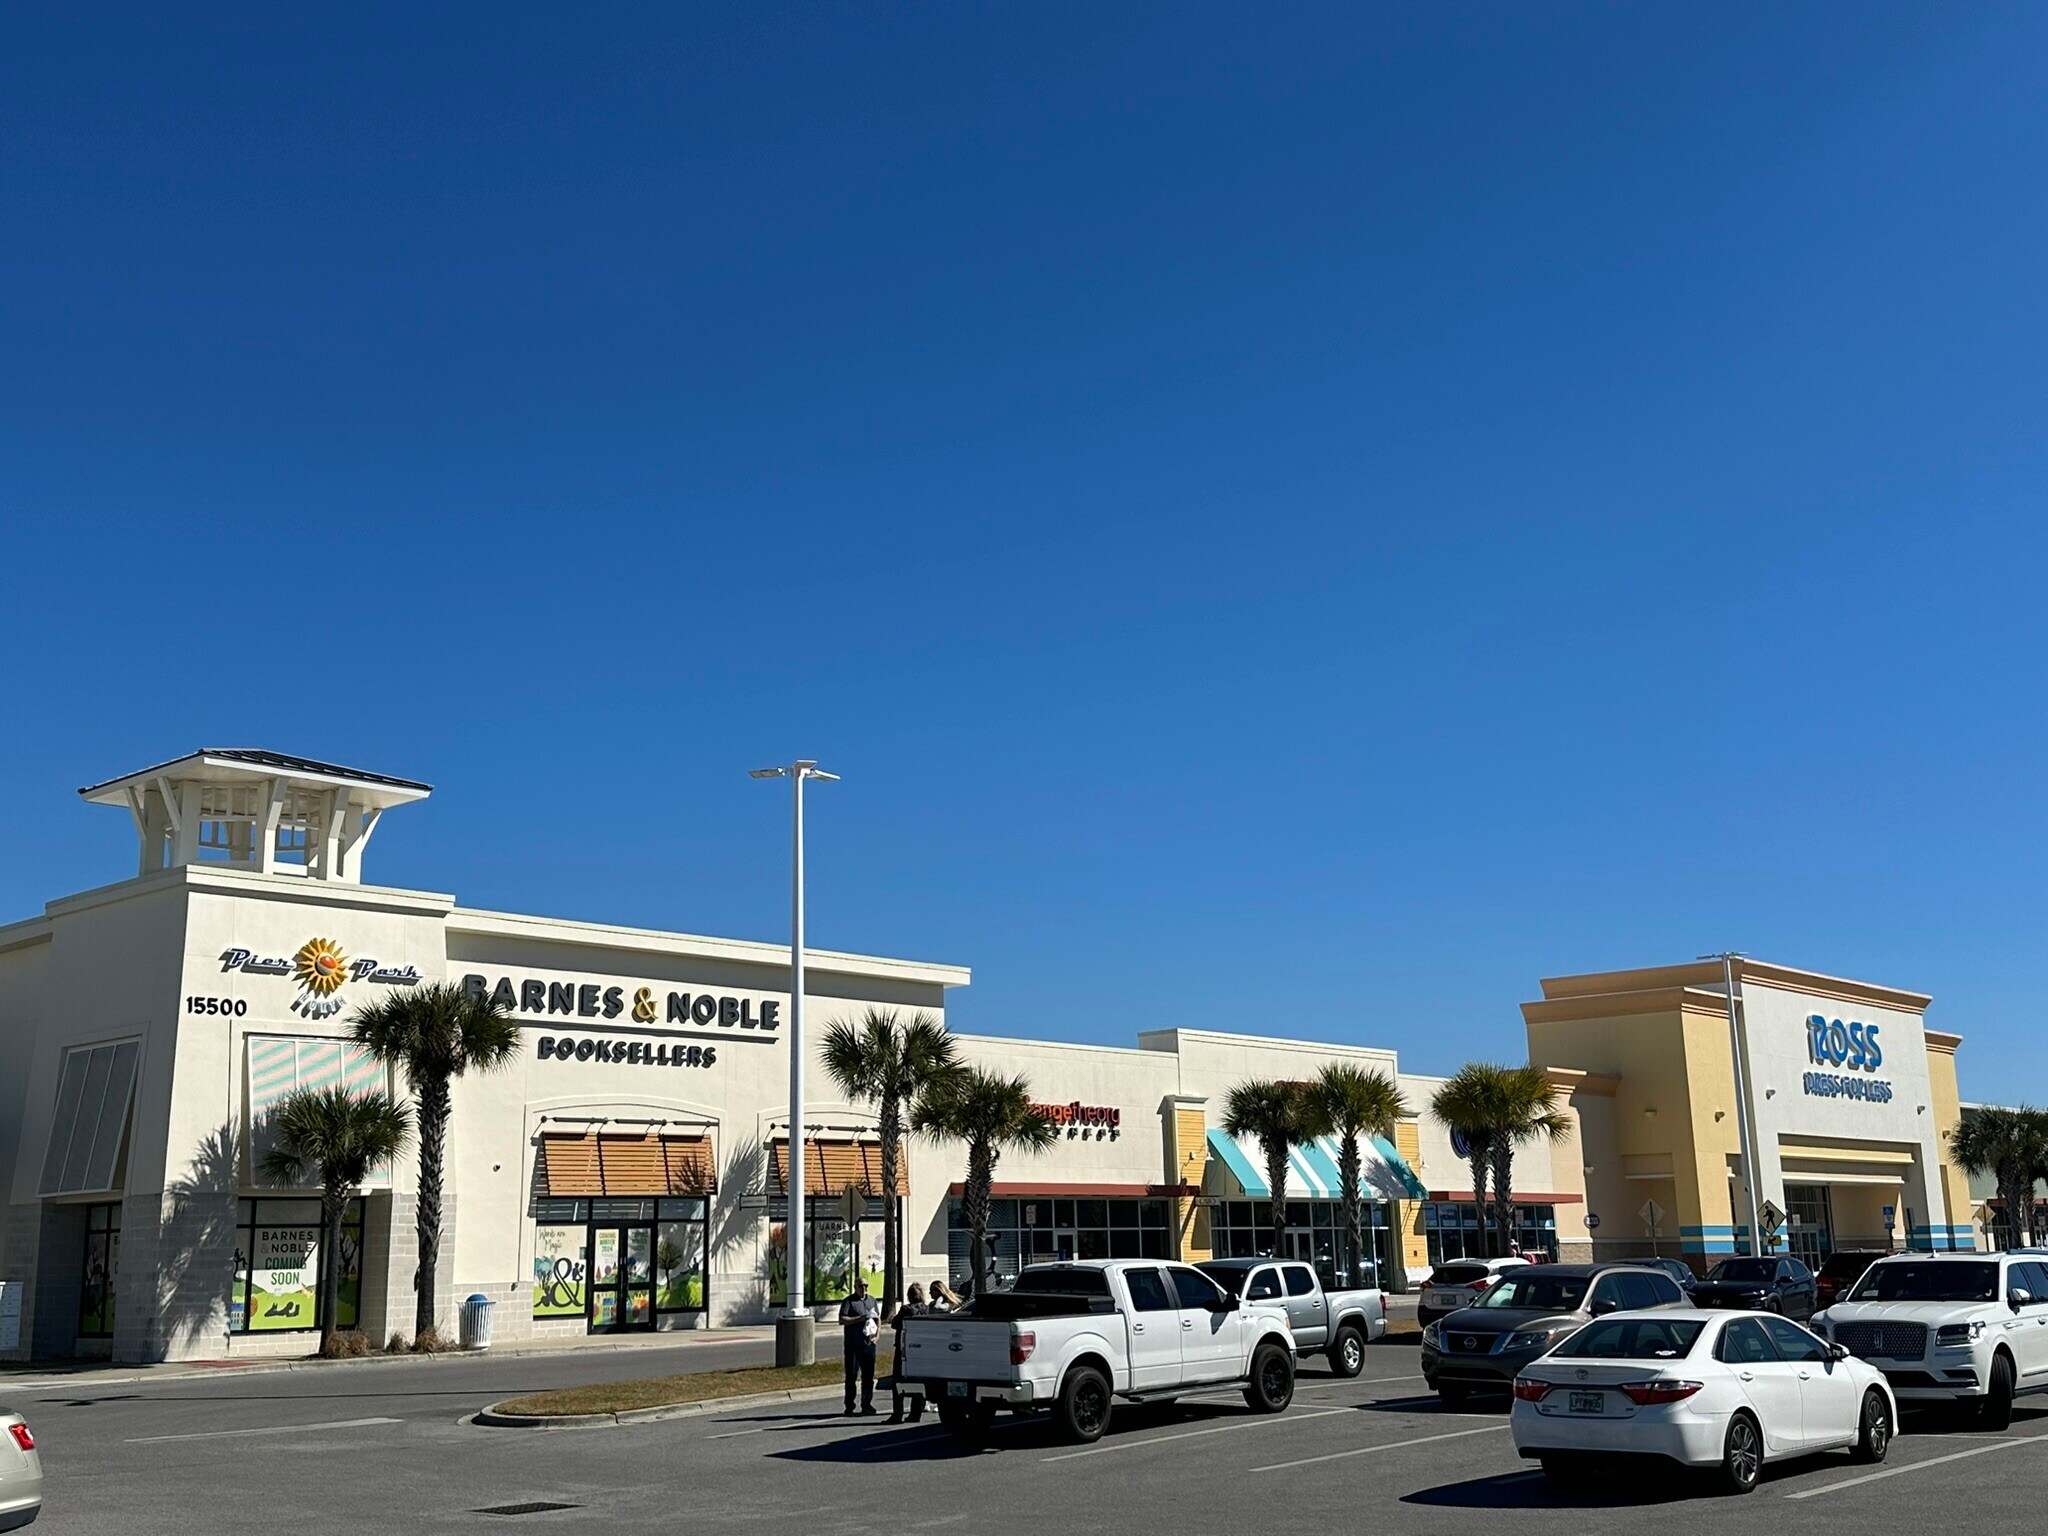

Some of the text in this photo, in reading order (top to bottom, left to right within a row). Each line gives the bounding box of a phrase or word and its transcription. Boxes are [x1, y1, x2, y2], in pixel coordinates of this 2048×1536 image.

[219, 947, 423, 985] Pier Park
[186, 996, 247, 1018] 15500
[462, 974, 780, 1031] BARNES & NOBLE
[537, 1036, 717, 1068] BOOKSELLERS
[1806, 1014, 1882, 1071] ROSS
[1803, 1072, 1841, 1096] DRESS
[1865, 1079, 1893, 1102] LESS
[262, 1231, 314, 1241] BARNES
[271, 1243, 313, 1253] NOBLE
[265, 1257, 307, 1270] COMING
[271, 1272, 300, 1285] SOON
